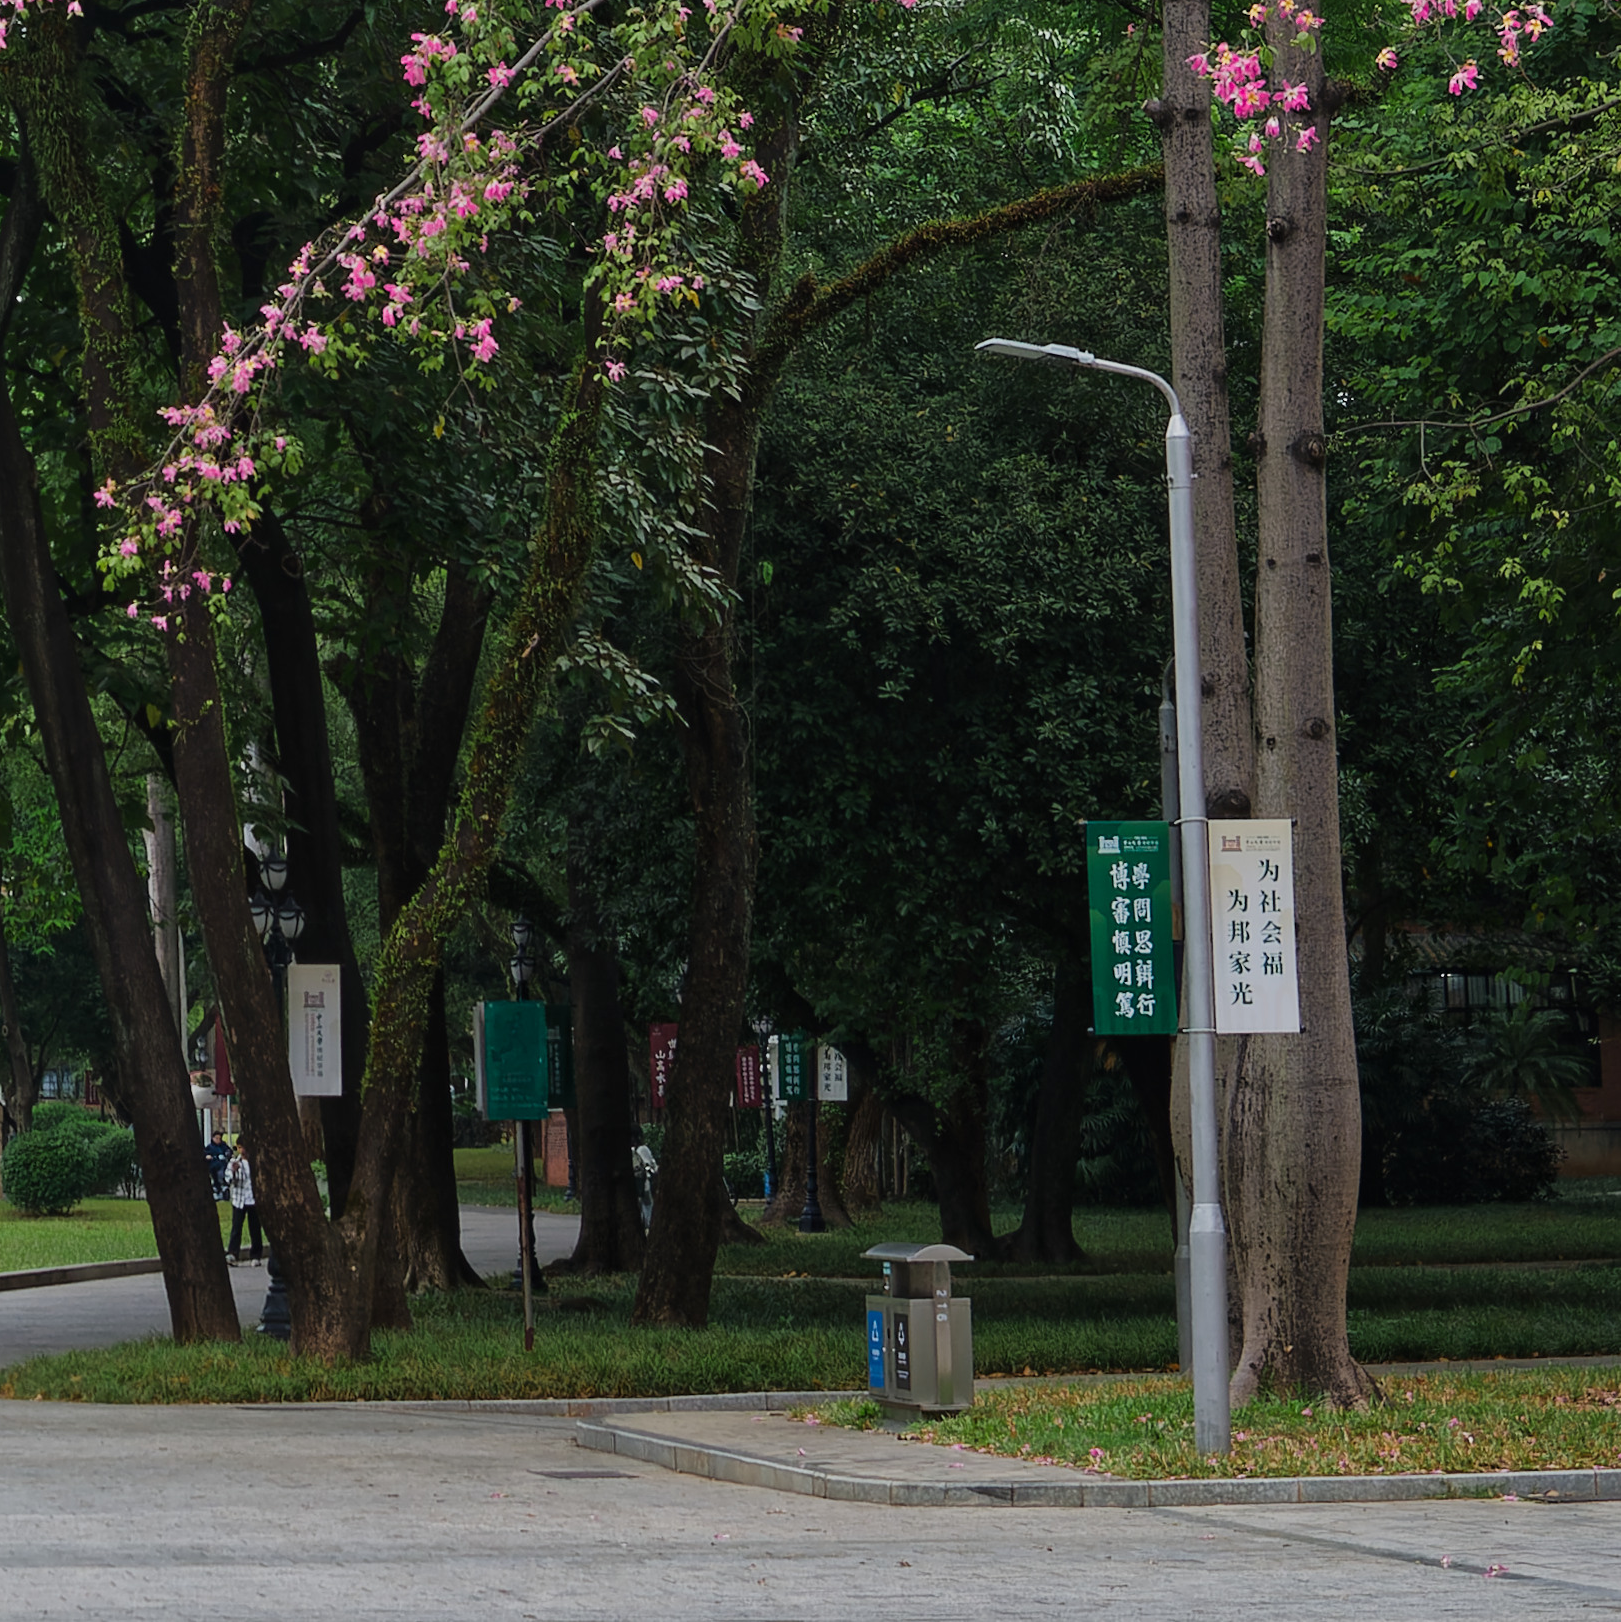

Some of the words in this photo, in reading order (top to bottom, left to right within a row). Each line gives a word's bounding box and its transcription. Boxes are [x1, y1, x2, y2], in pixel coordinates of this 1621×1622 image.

[1227, 889, 1253, 1005] 为邦家光
[1258, 859, 1283, 975] 为社会福
[935, 1289, 948, 1322] 216
